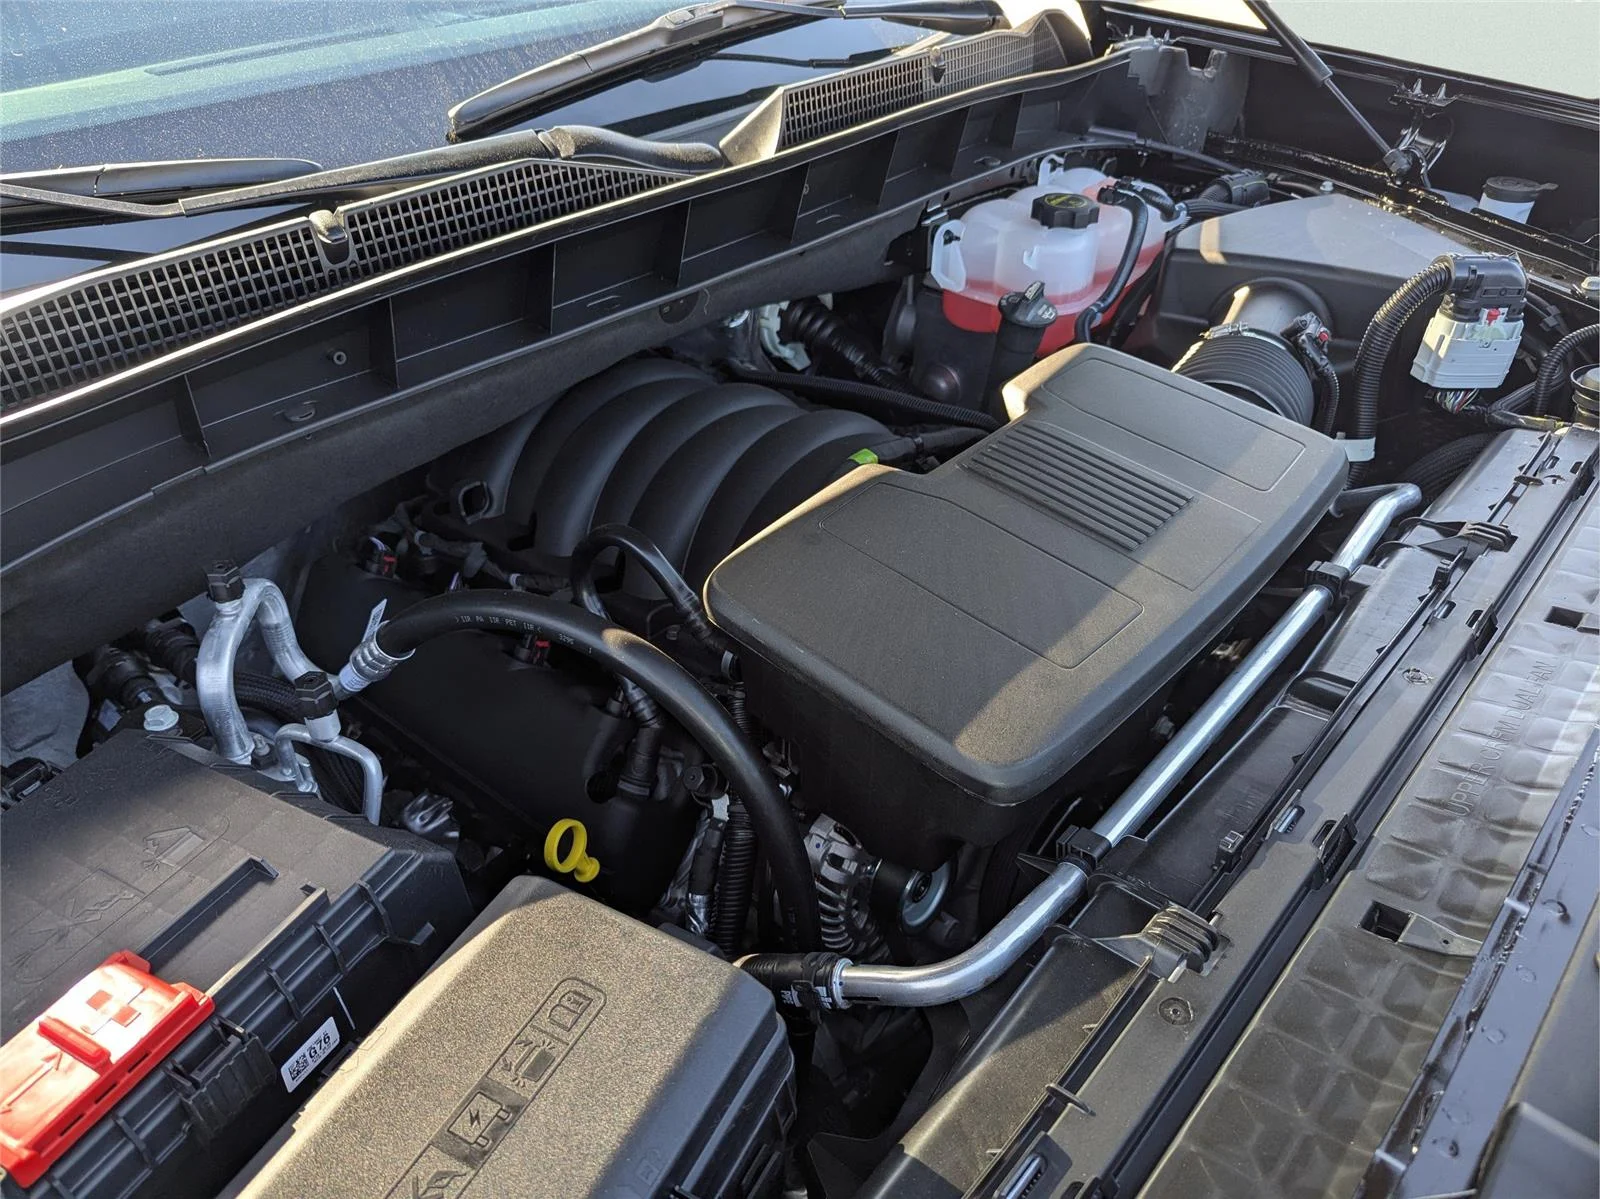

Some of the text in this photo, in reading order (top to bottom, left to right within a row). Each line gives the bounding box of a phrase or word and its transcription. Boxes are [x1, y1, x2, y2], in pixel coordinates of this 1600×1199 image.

[1448, 762, 1492, 816] UPPER
[1506, 688, 1541, 720] DUAL
[308, 1034, 331, 1059] G76
